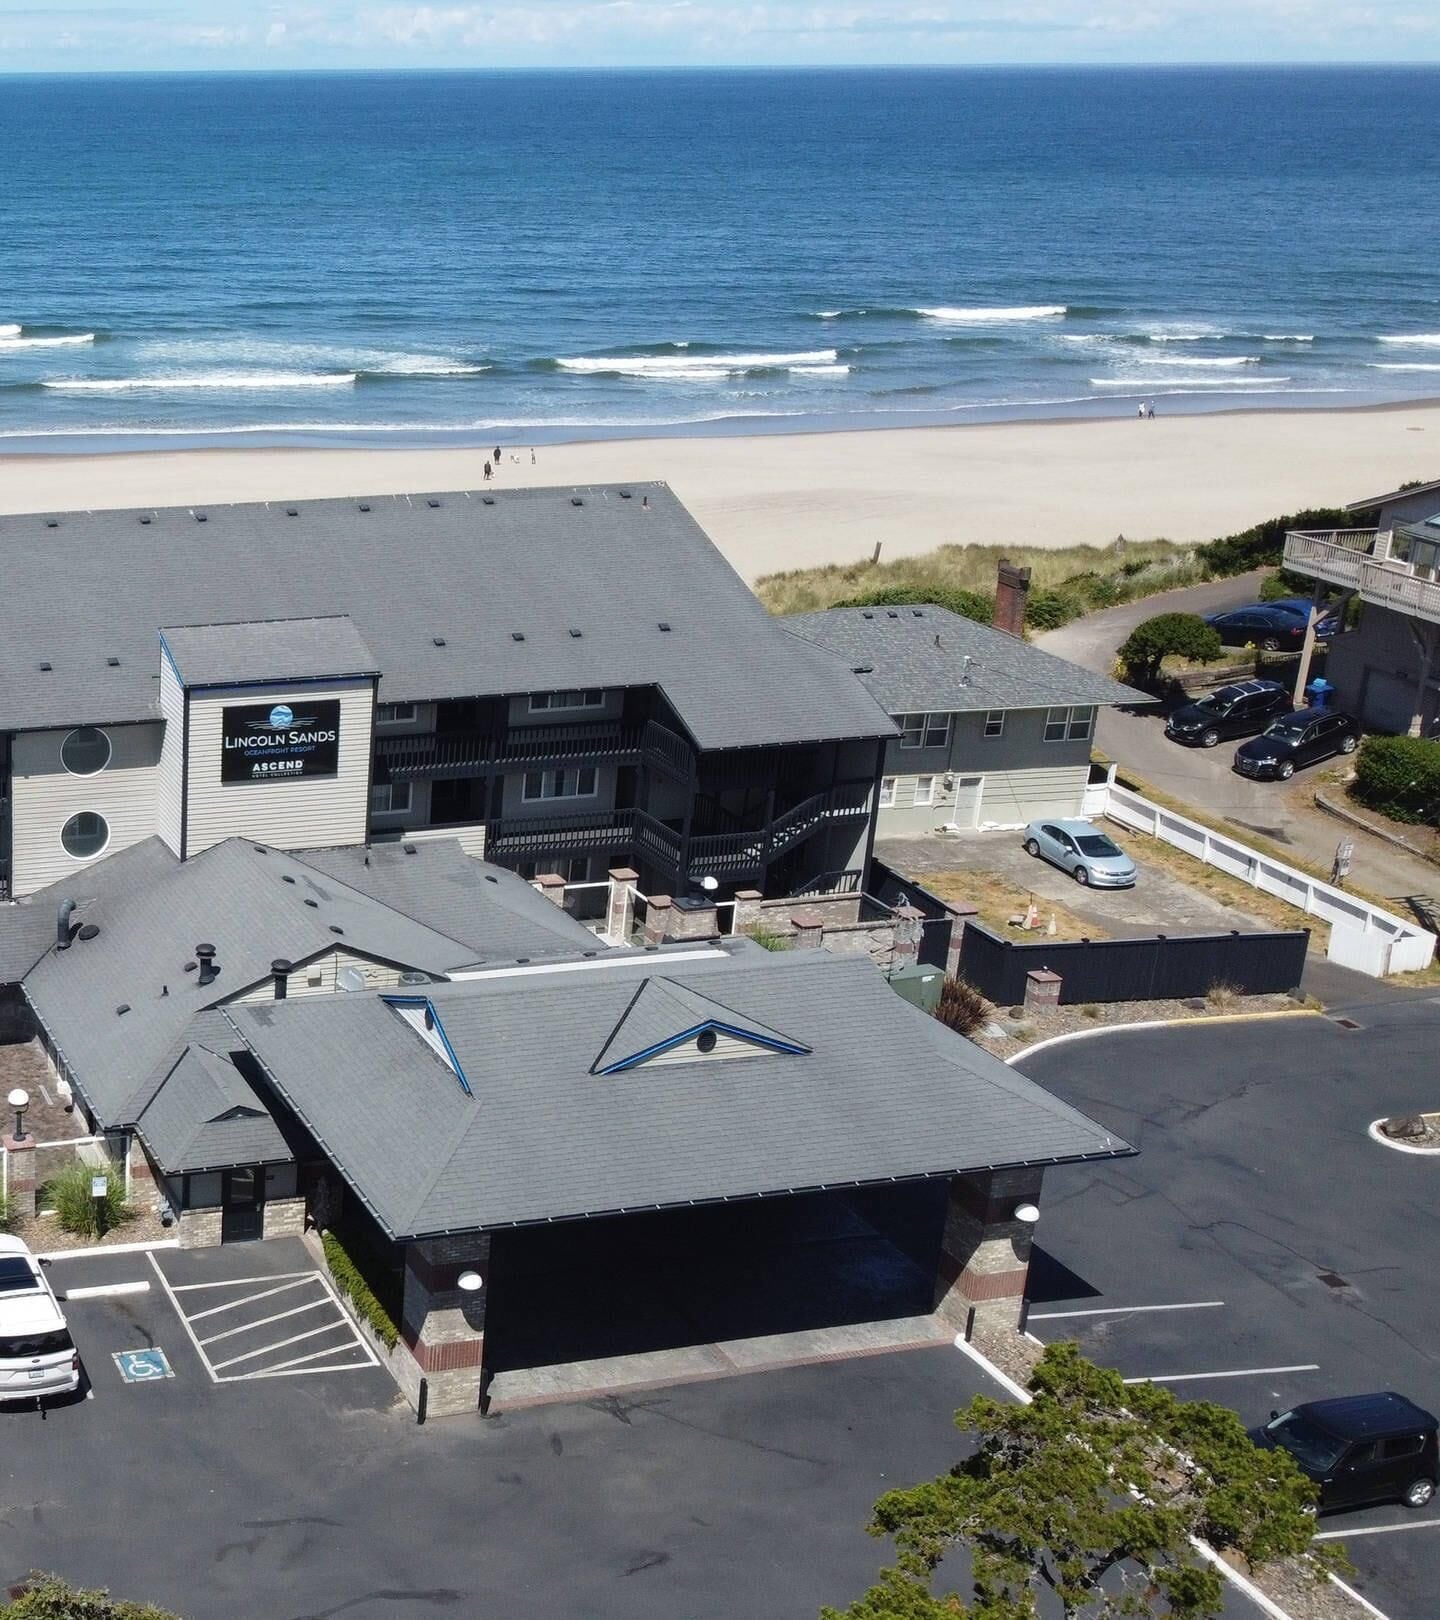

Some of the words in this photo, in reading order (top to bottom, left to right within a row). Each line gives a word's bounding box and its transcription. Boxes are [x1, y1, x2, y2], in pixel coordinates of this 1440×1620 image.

[225, 735, 285, 749] LINCOLN
[289, 730, 336, 744] SANDS
[252, 760, 303, 771] ASCEND
